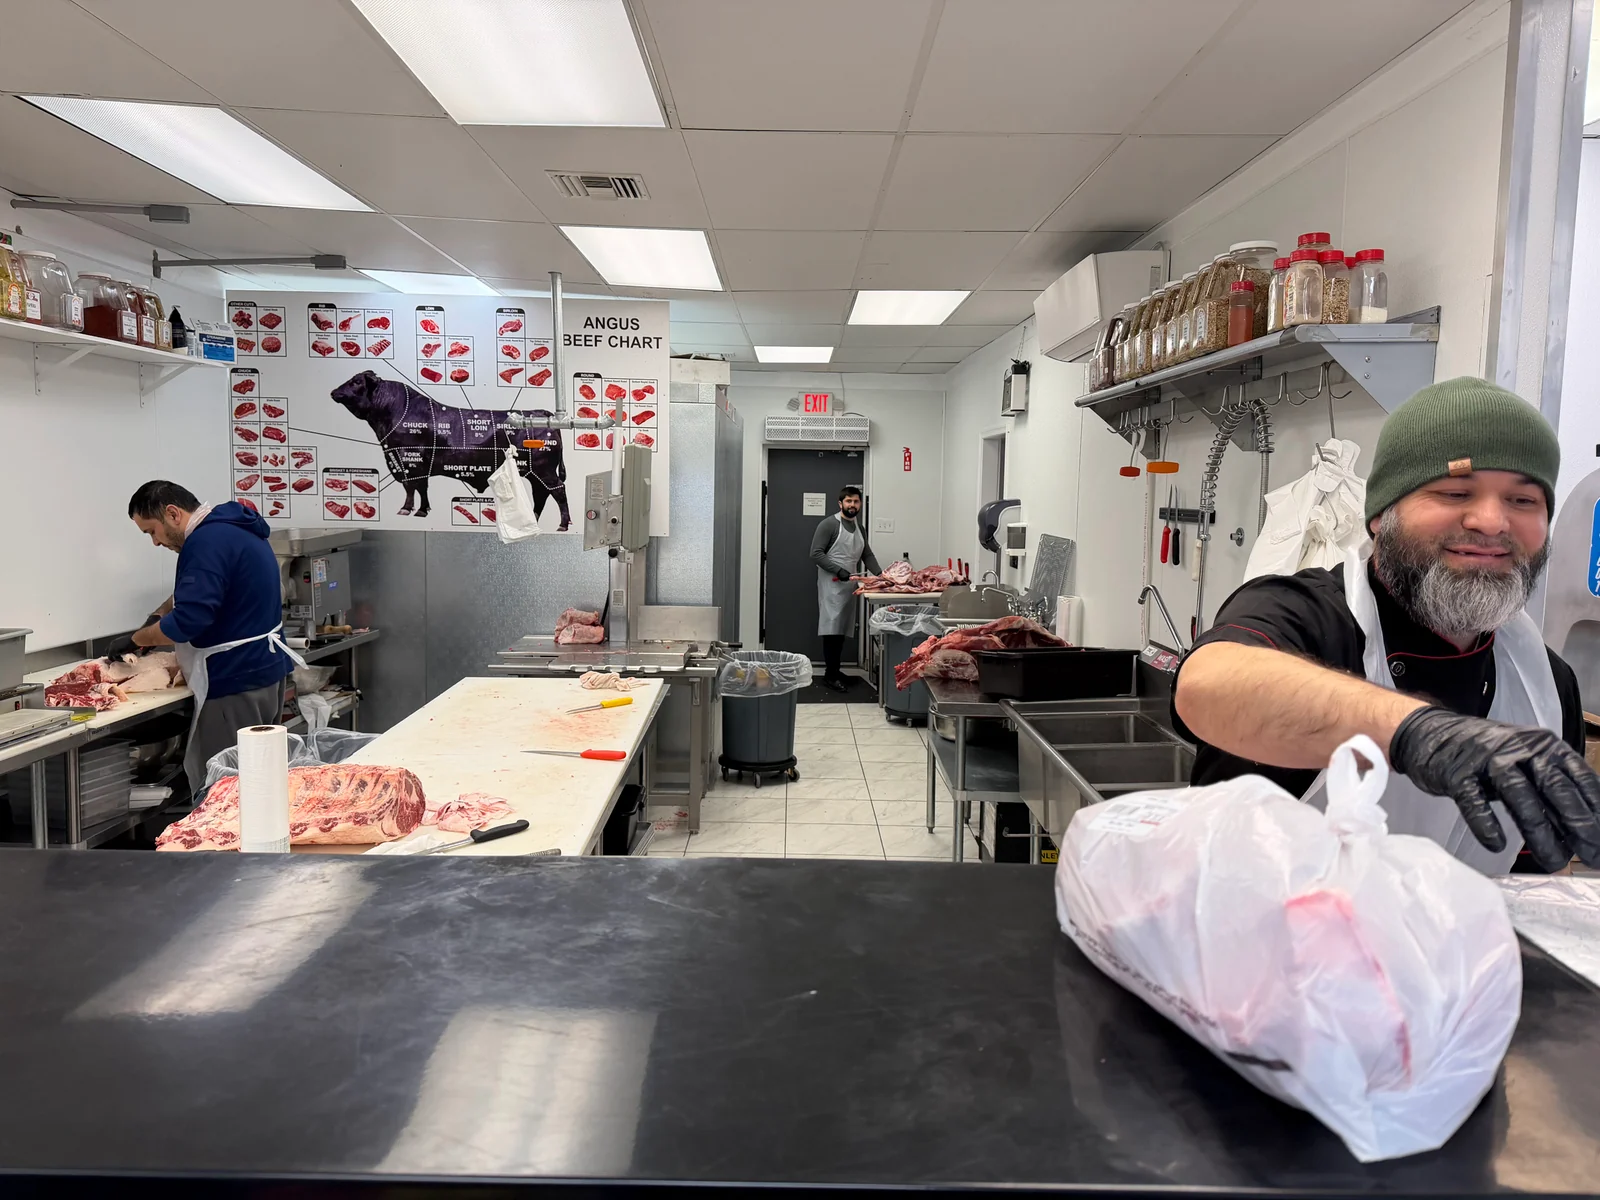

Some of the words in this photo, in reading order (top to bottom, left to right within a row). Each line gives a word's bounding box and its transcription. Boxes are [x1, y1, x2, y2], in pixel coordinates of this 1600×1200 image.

[583, 316, 640, 330] ANGUS
[563, 334, 602, 347] BEEF
[608, 336, 662, 349] CHART
[805, 394, 828, 412] EXIT
